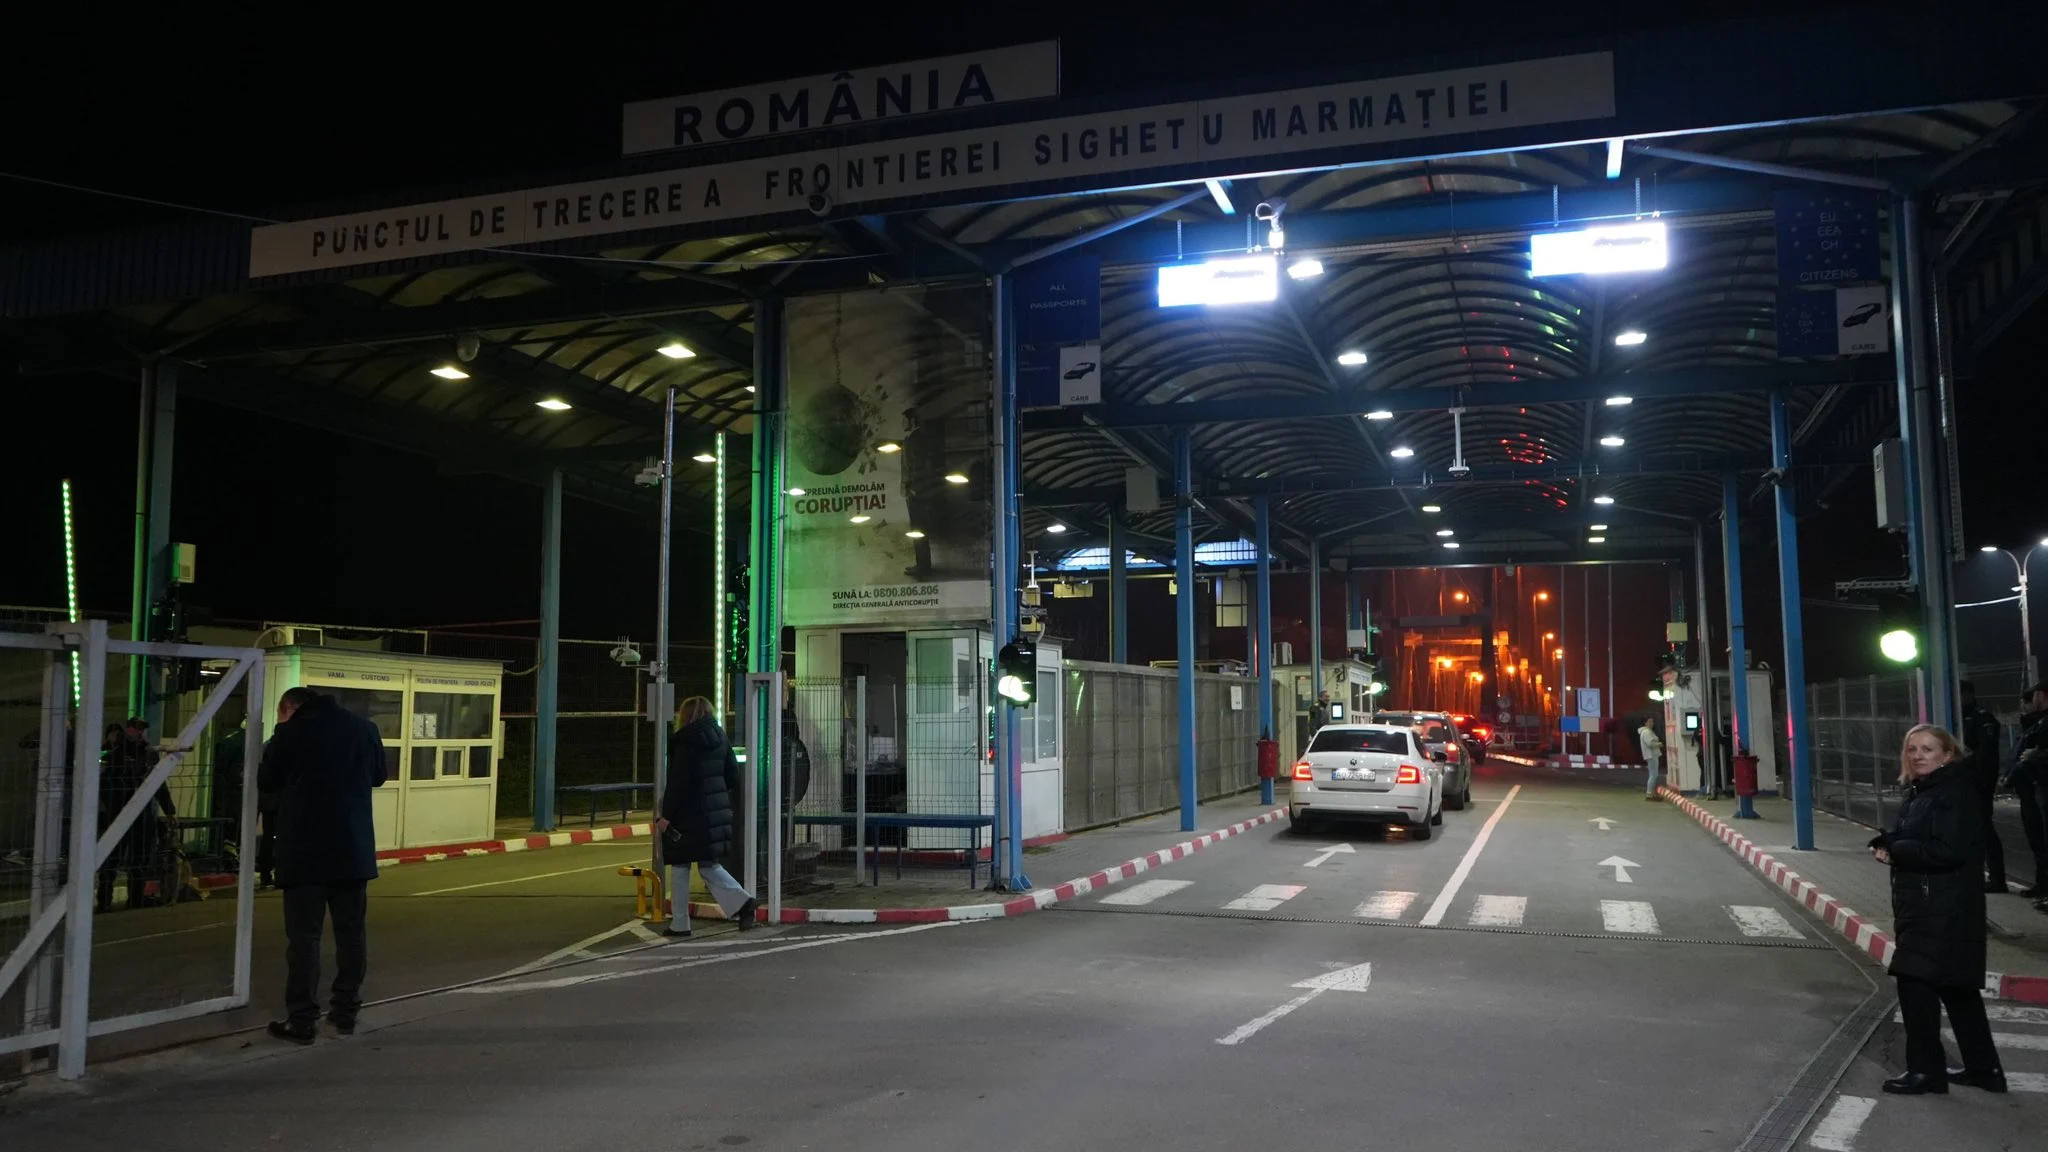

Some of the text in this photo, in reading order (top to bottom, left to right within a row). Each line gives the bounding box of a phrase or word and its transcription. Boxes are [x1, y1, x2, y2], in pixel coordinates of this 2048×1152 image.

[674, 64, 995, 145] ROMÂNIA
[312, 214, 449, 257] PUNCTUL
[470, 206, 505, 237] DE
[533, 183, 682, 228] TRECERE
[703, 179, 721, 208] A
[765, 141, 1000, 200] FRONTIEREI
[1252, 80, 1508, 141] MARMAȚIEI
[1819, 211, 1836, 223] EU
[1817, 225, 1842, 237] EEA
[1821, 240, 1839, 250] CH
[1800, 268, 1859, 282] CITIZENS
[1049, 283, 1067, 292] ALL
[1030, 298, 1087, 310] PASSPORTS
[803, 482, 885, 496] PREUNĂ DEMOLĂM
[794, 494, 886, 514] CORUPȚIA!
[832, 585, 939, 600] SUNĂ LA: 0800.806.806
[833, 599, 939, 610] DIRECȚIA GENERALĂ ANTICORUPȚIE
[361, 674, 390, 682] CUSTOMS
